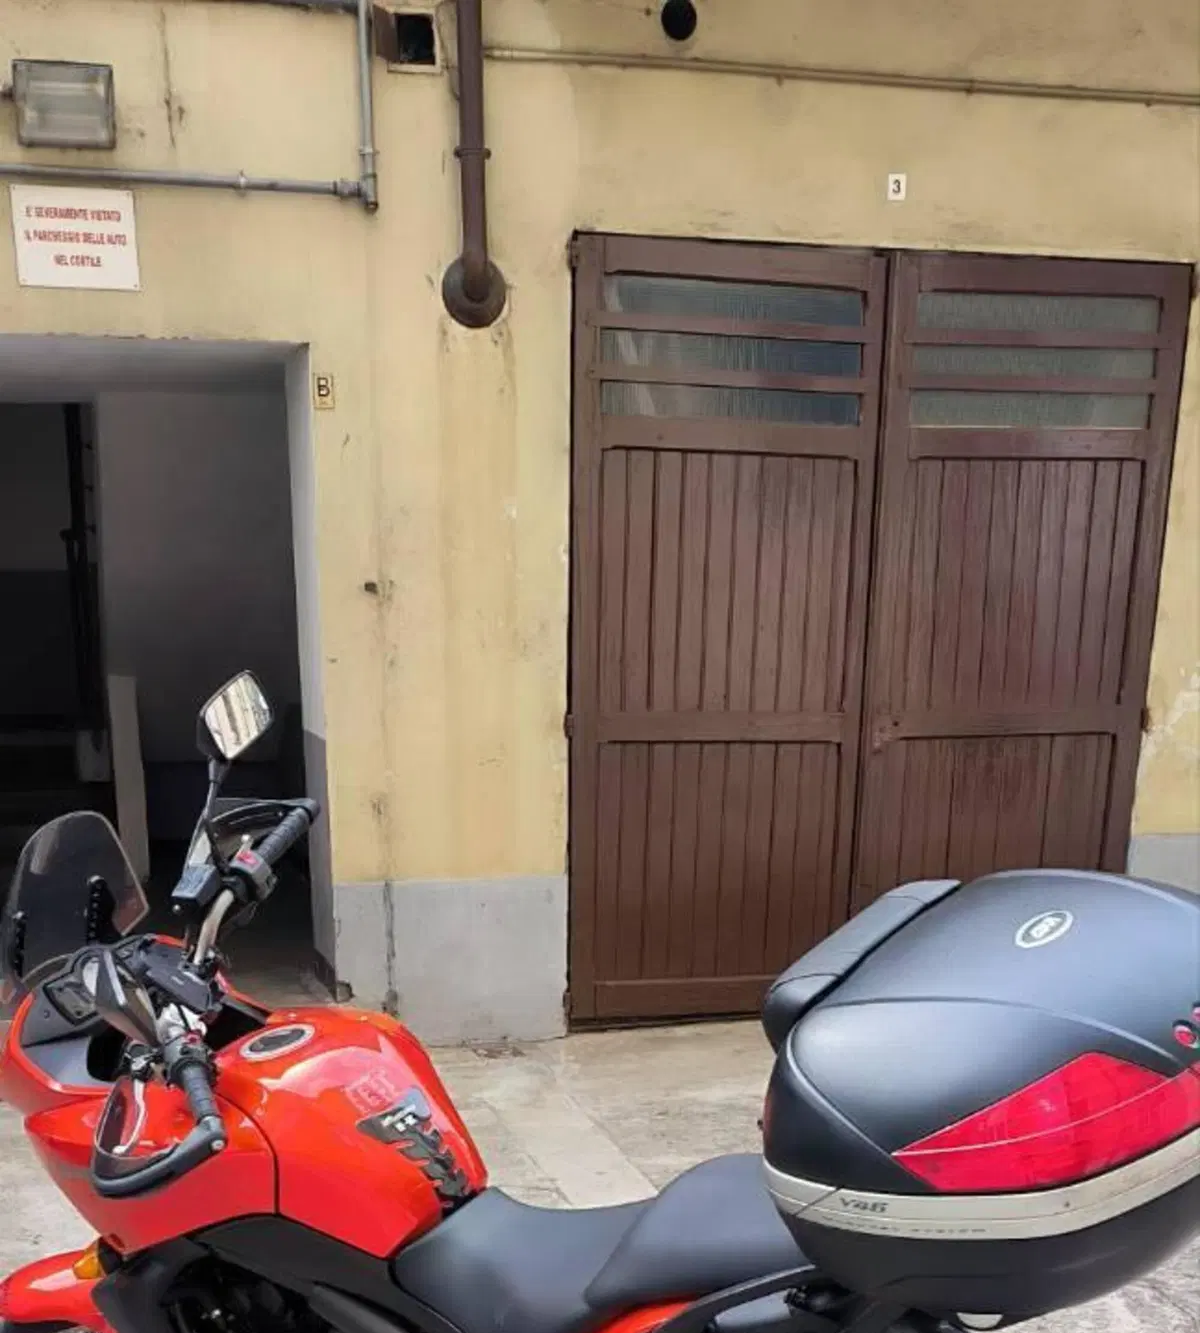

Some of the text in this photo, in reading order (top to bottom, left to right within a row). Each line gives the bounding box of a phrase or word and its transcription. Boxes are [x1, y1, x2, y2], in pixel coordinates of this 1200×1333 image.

[892, 179, 901, 193] 3
[82, 232, 105, 245] DELLE
[106, 234, 127, 246] AUTO
[54, 254, 102, 268] NEL CORTILE
[317, 377, 330, 397] B
